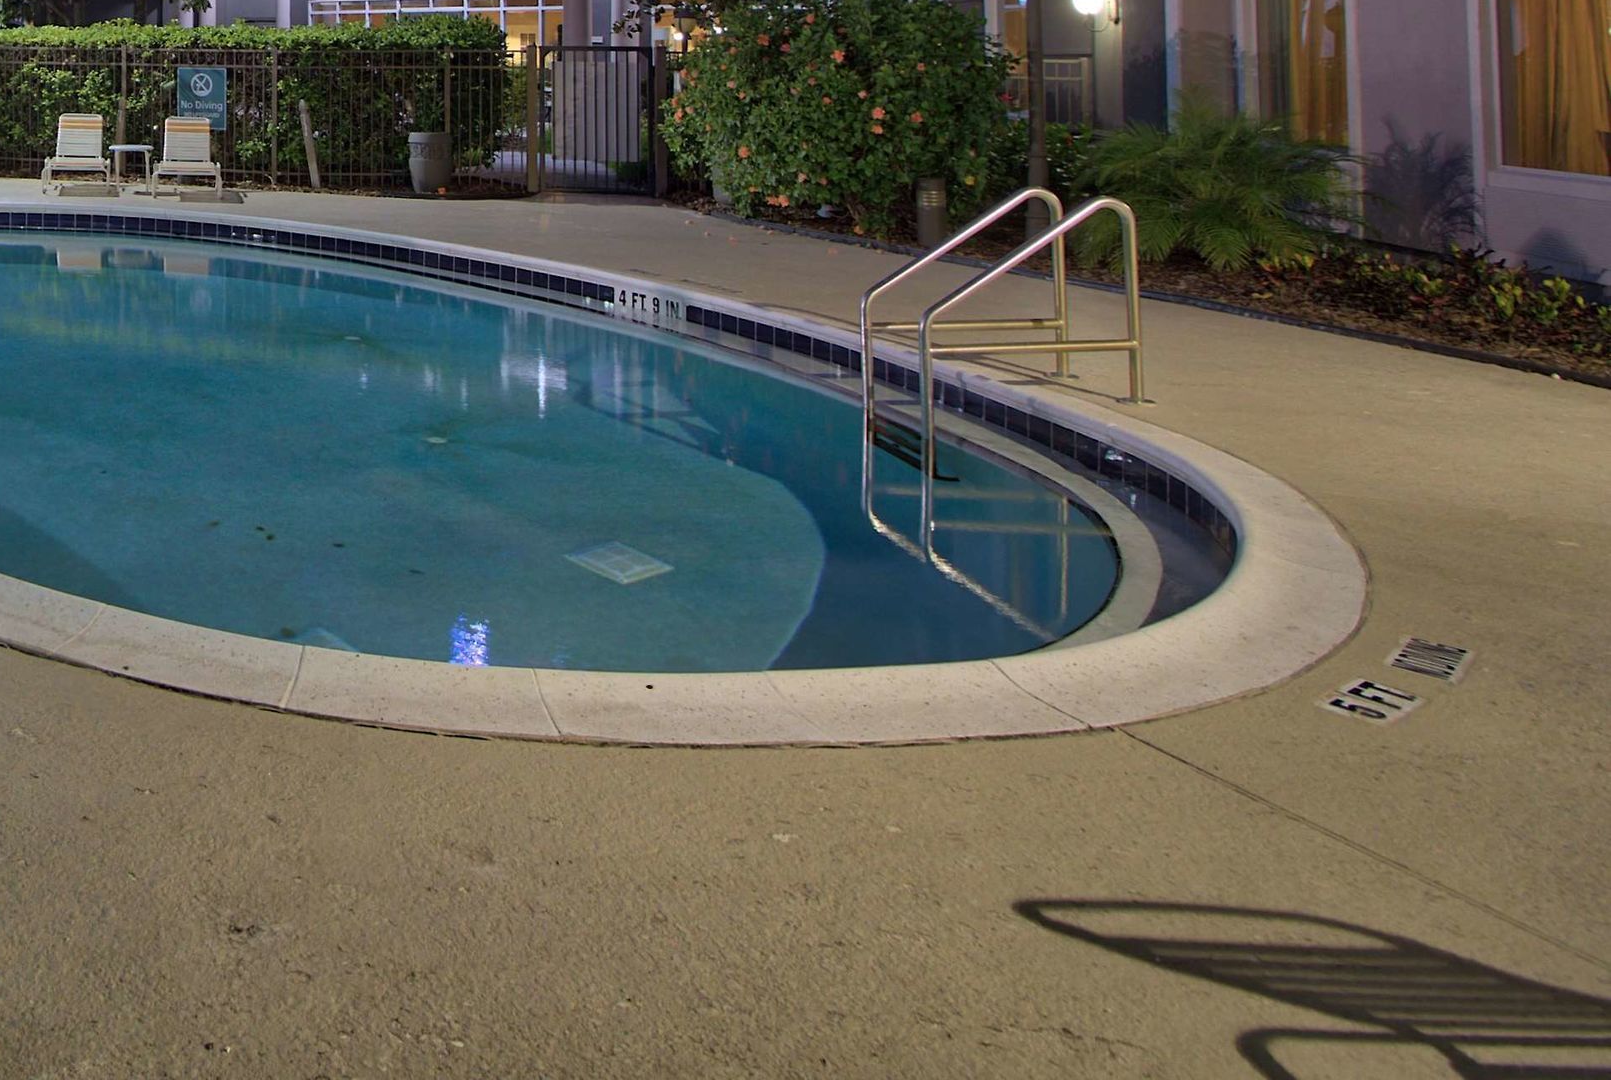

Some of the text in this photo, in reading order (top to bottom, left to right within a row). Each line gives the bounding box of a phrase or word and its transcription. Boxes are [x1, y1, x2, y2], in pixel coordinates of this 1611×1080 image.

[180, 100, 223, 111] No Diving
[619, 290, 626, 306] 4
[652, 297, 660, 313] 9
[1328, 697, 1388, 720] 5
